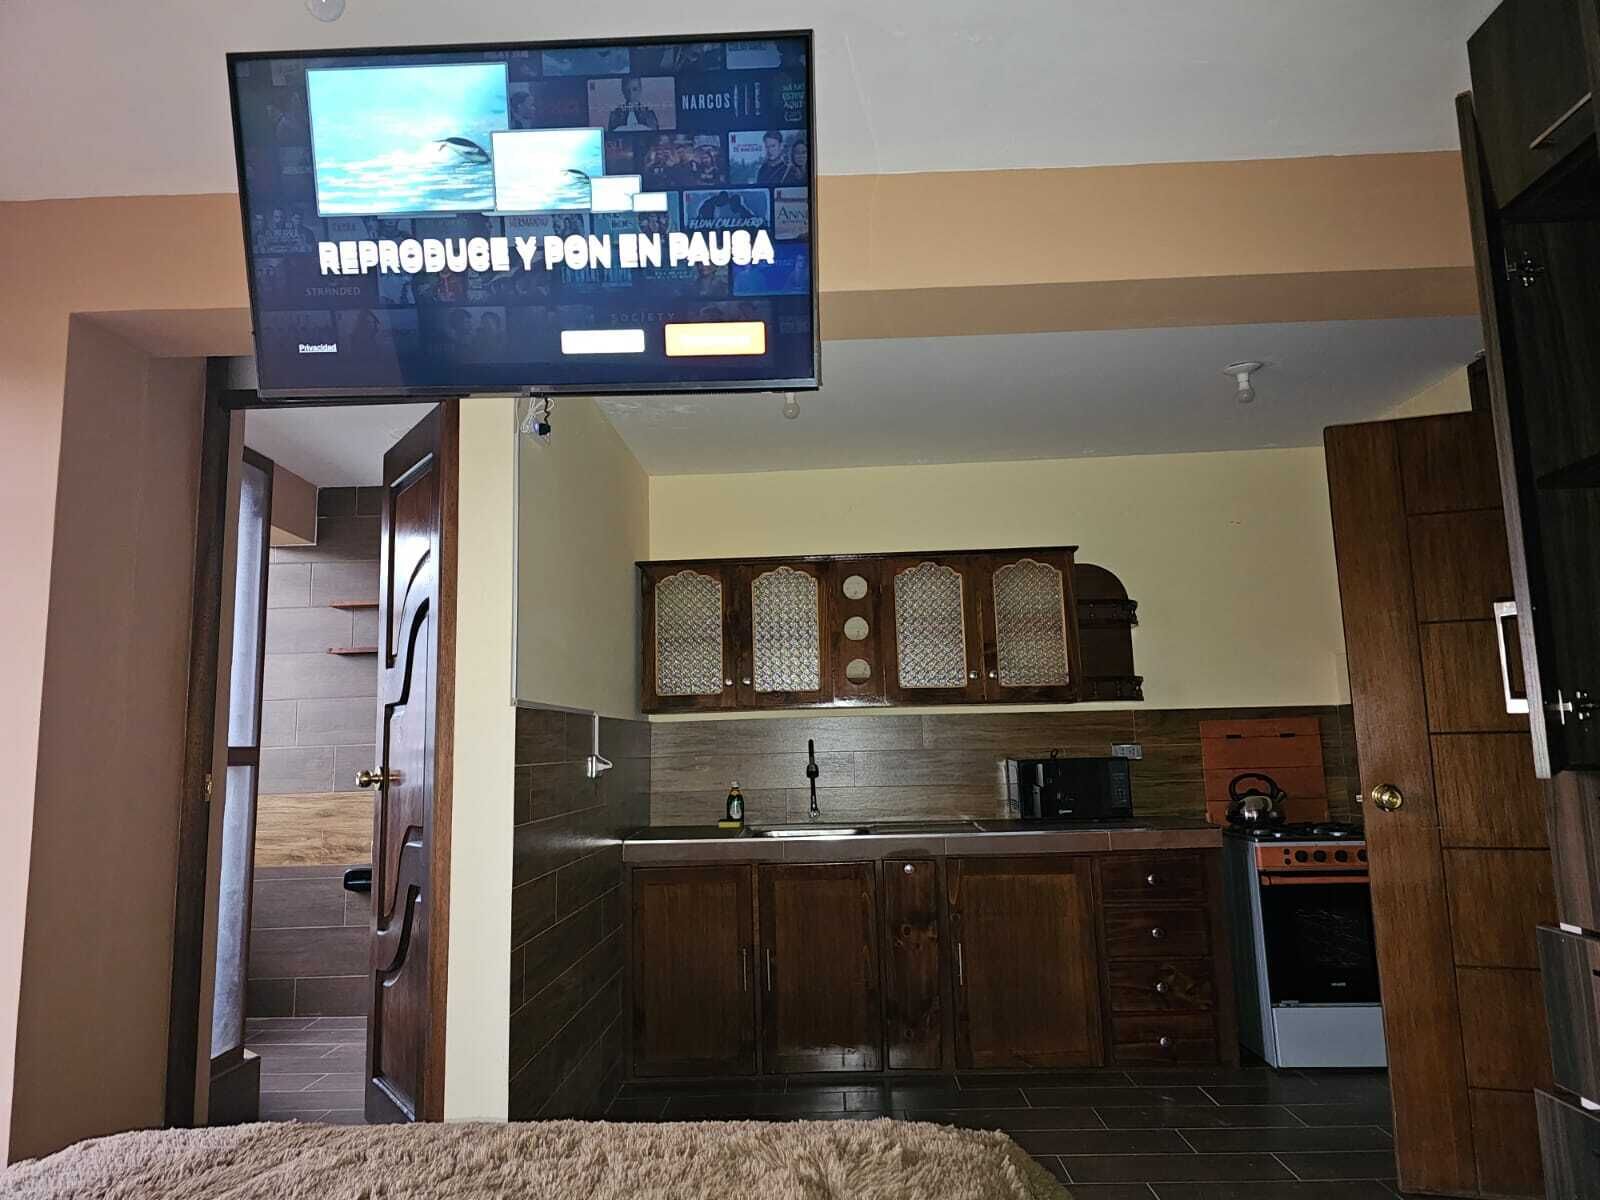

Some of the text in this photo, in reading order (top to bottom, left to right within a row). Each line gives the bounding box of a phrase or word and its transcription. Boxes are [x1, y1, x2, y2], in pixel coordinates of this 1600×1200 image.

[681, 93, 731, 111] NARCOS
[318, 229, 775, 276] REPRODUCE Y PON EN PAUSA
[304, 286, 361, 297] STRANDED
[609, 312, 676, 323] SOCIETY
[298, 342, 338, 353] Privacidad
